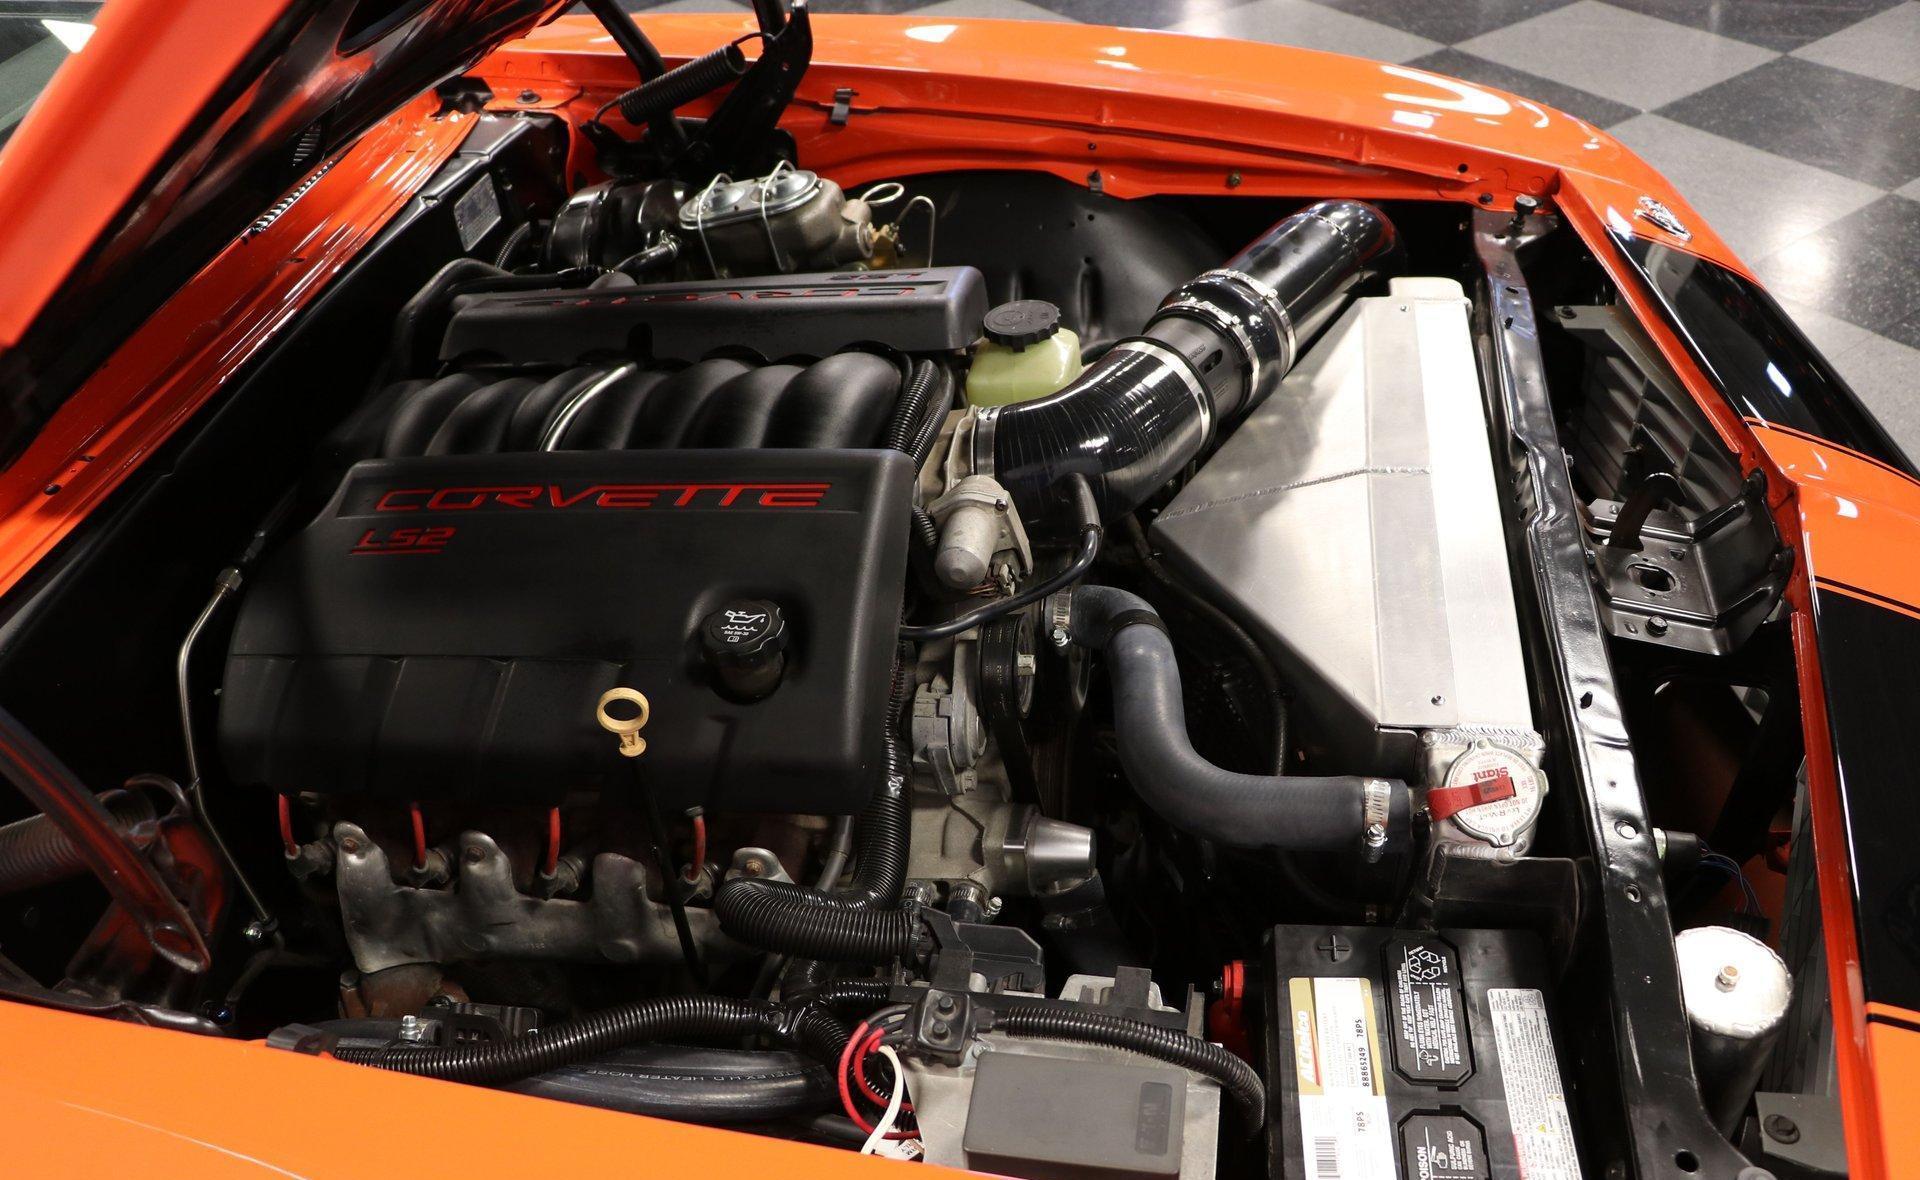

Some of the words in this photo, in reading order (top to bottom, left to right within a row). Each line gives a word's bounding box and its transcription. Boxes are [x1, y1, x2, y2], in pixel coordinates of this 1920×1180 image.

[375, 483, 831, 512] CORVETTE
[354, 526, 456, 549] LS2
[1473, 767, 1508, 782] Stant
[1355, 1019, 1364, 1038] 78PS
[1296, 1010, 1314, 1082] ACDelco
[1358, 1047, 1370, 1087] 88865249
[1356, 1111, 1366, 1132] 78PS
[1417, 1146, 1430, 1180] OISON
[1448, 1144, 1457, 1170] SULFURIC
